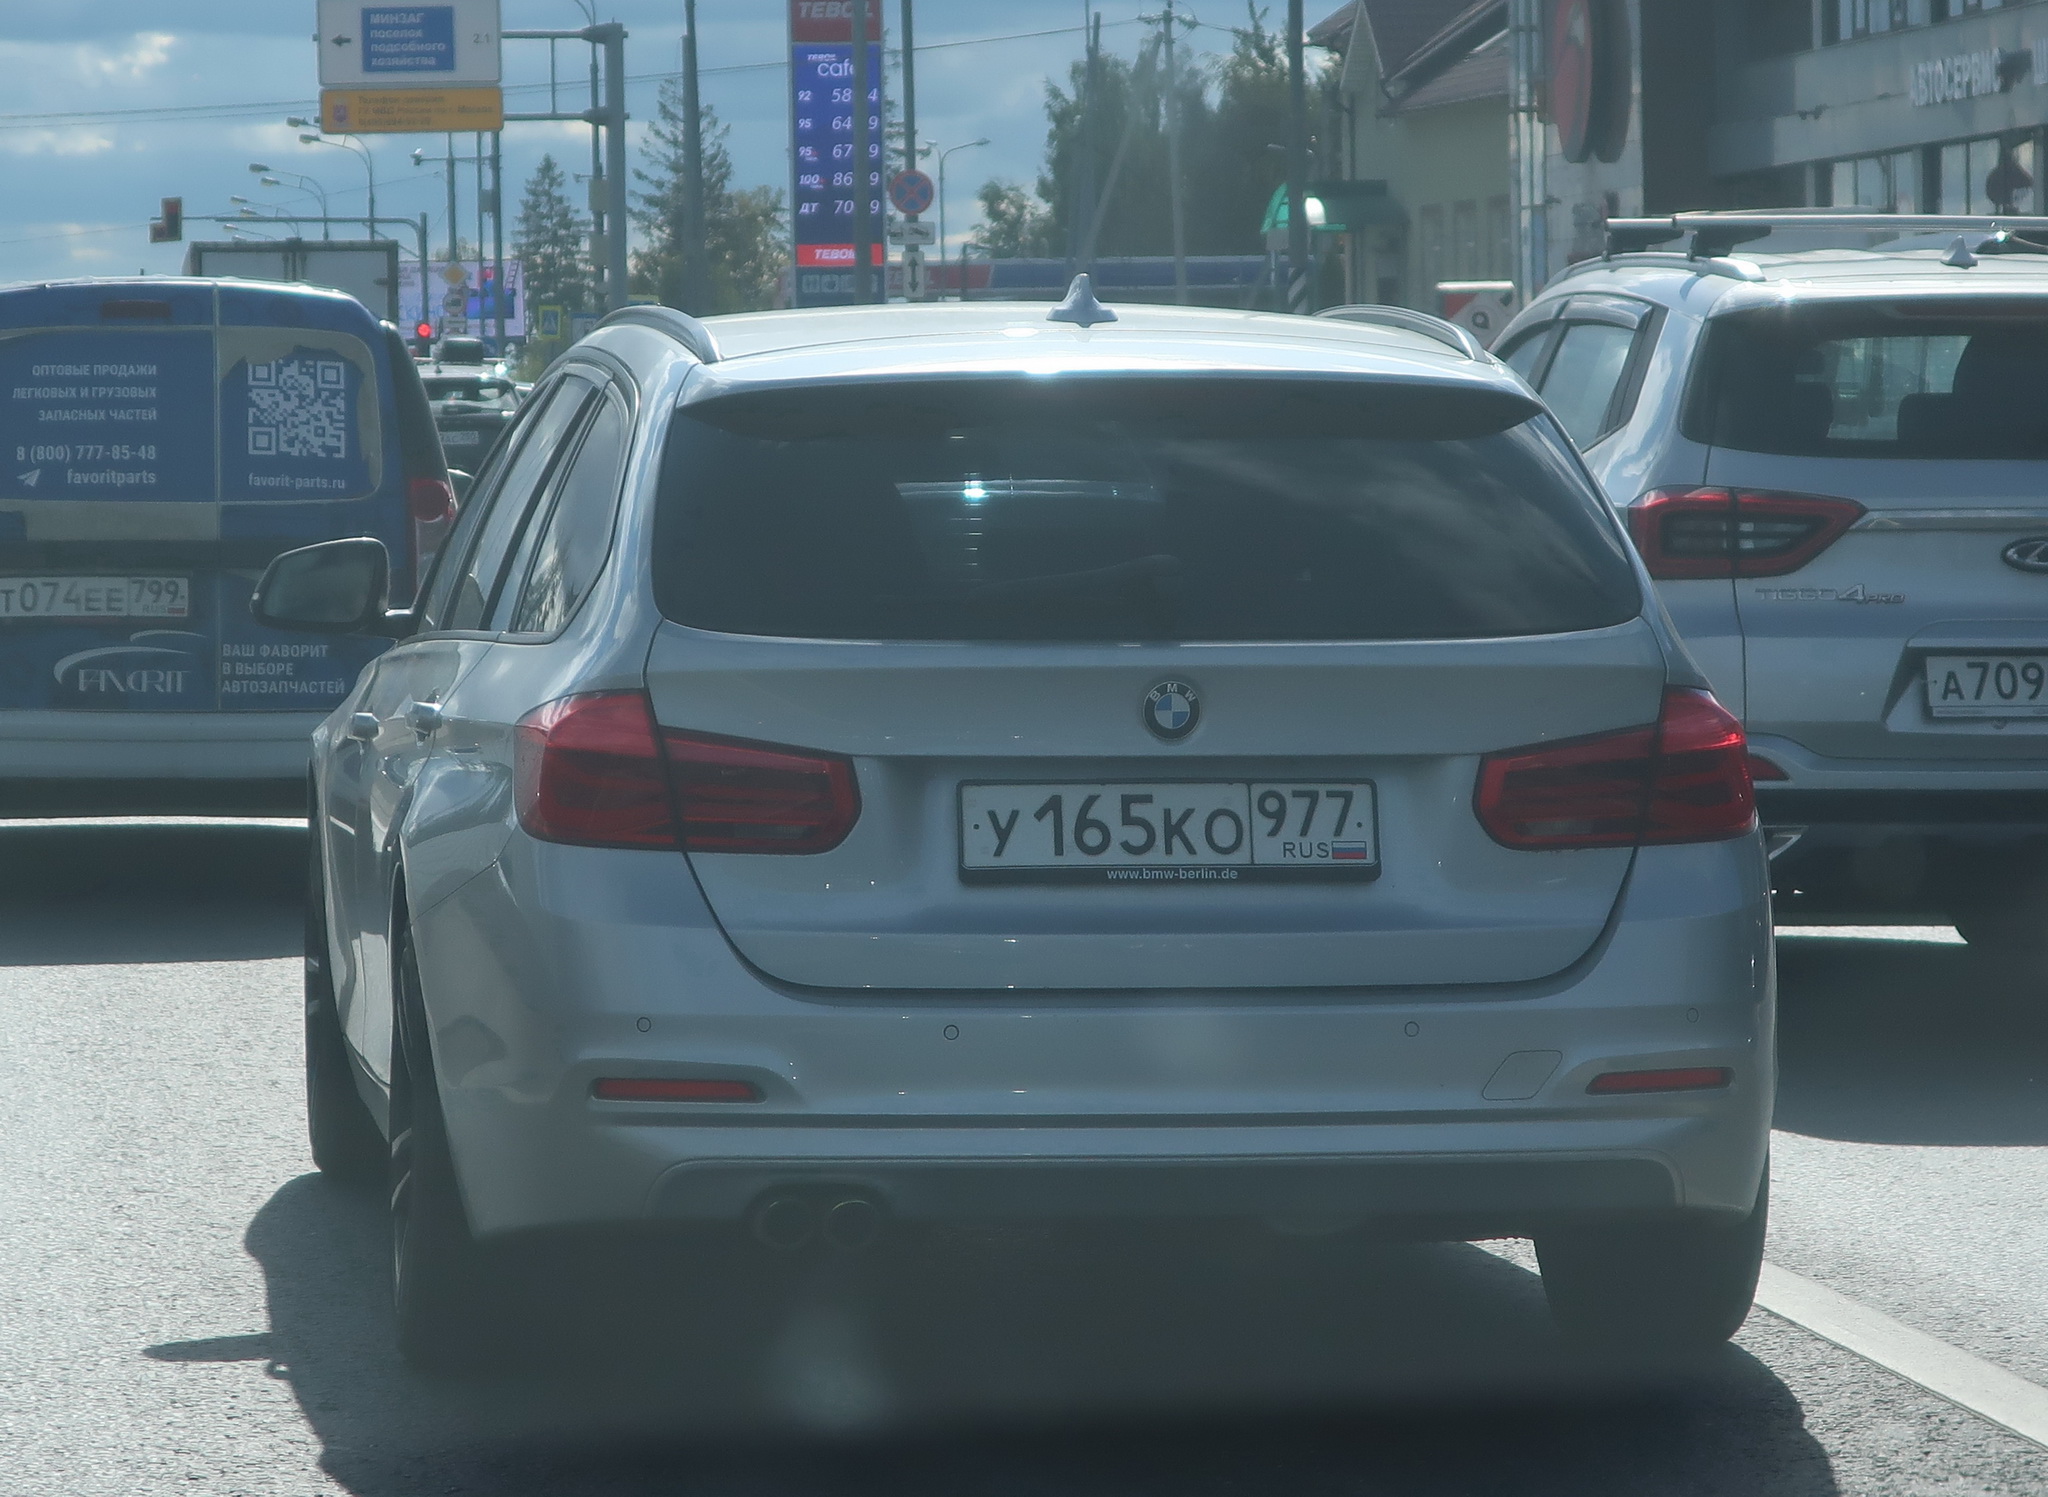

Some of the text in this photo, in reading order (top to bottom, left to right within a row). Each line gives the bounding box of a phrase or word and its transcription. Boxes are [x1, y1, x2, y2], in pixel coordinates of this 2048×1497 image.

[799, 1, 873, 18] TEBOL
[370, 13, 424, 24] МИНЗАГ
[473, 33, 490, 44] 2.1
[371, 41, 446, 52] подсобного
[371, 55, 436, 67] хозяйства
[1910, 47, 2001, 107] АВТОСЕРВИС
[798, 90, 811, 101] 92
[798, 118, 812, 129] 95
[798, 146, 812, 157] 95
[799, 173, 820, 184] 100
[799, 203, 820, 214] ДТ
[32, 364, 157, 378] ОПТОВЫЕ ПРОДАЖИ
[12, 387, 157, 399] ЛЕГКОВЫХ И ГРУЗОВЫХ
[38, 407, 157, 421] ЗАПАСНЫХ ЧАСТЕЙ
[16, 444, 157, 463] 8 (800) 777-85-48
[67, 468, 157, 487] favoritparts
[248, 472, 345, 489] favorit-parts.ru
[131, 579, 180, 603] 799
[142, 604, 167, 614] RUS
[222, 643, 329, 658] ВАШ ФАВОРИТ
[222, 662, 294, 675] В ВЫБОРЕ
[221, 678, 346, 694] АВТОЗАПЧАСТЕЙ
[1150, 683, 1196, 702] BMW
[1257, 790, 1354, 837] 977
[1282, 842, 1330, 859] RUS
[1107, 868, 1239, 880] www.bmw-berlin.de
